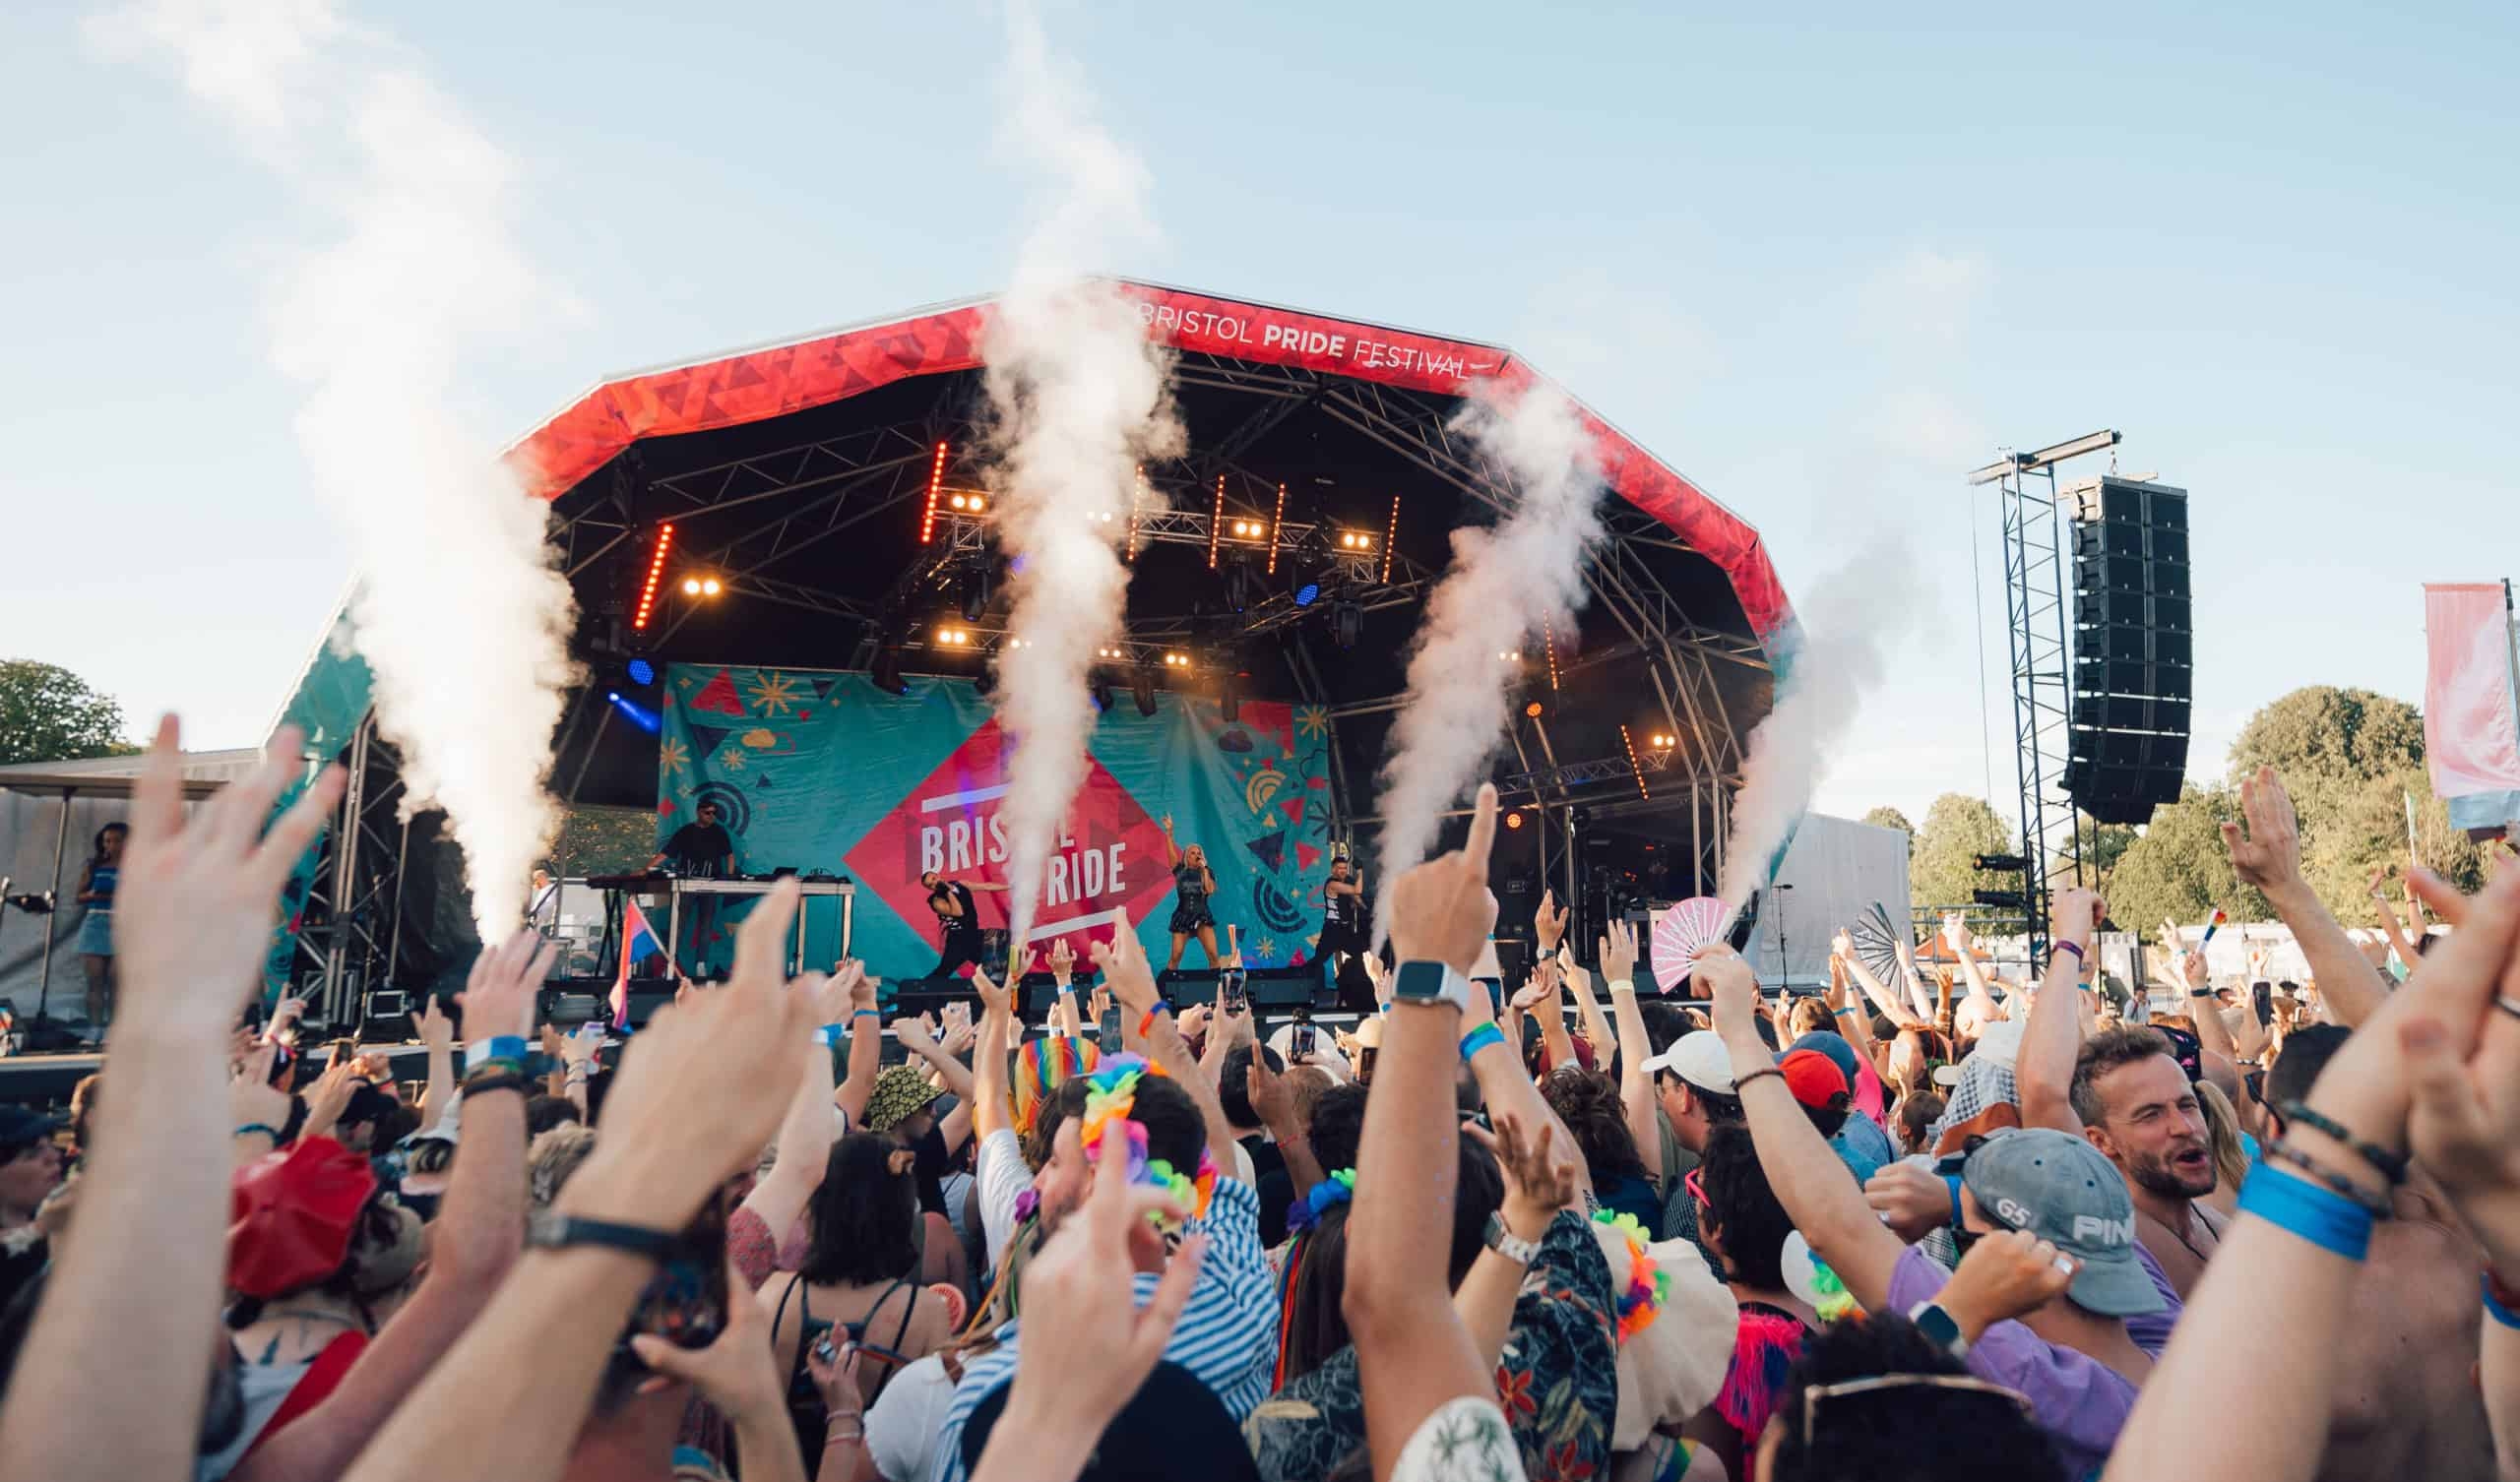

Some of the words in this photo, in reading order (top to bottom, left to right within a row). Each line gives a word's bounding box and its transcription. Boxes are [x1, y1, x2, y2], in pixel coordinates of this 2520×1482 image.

[1139, 303, 1253, 344] BRISTOL
[1263, 324, 1347, 358] PRIDE
[1354, 340, 1470, 380] FESTIVAL
[1045, 841, 1126, 906] RIDE
[2072, 1211, 2135, 1245] PIN
